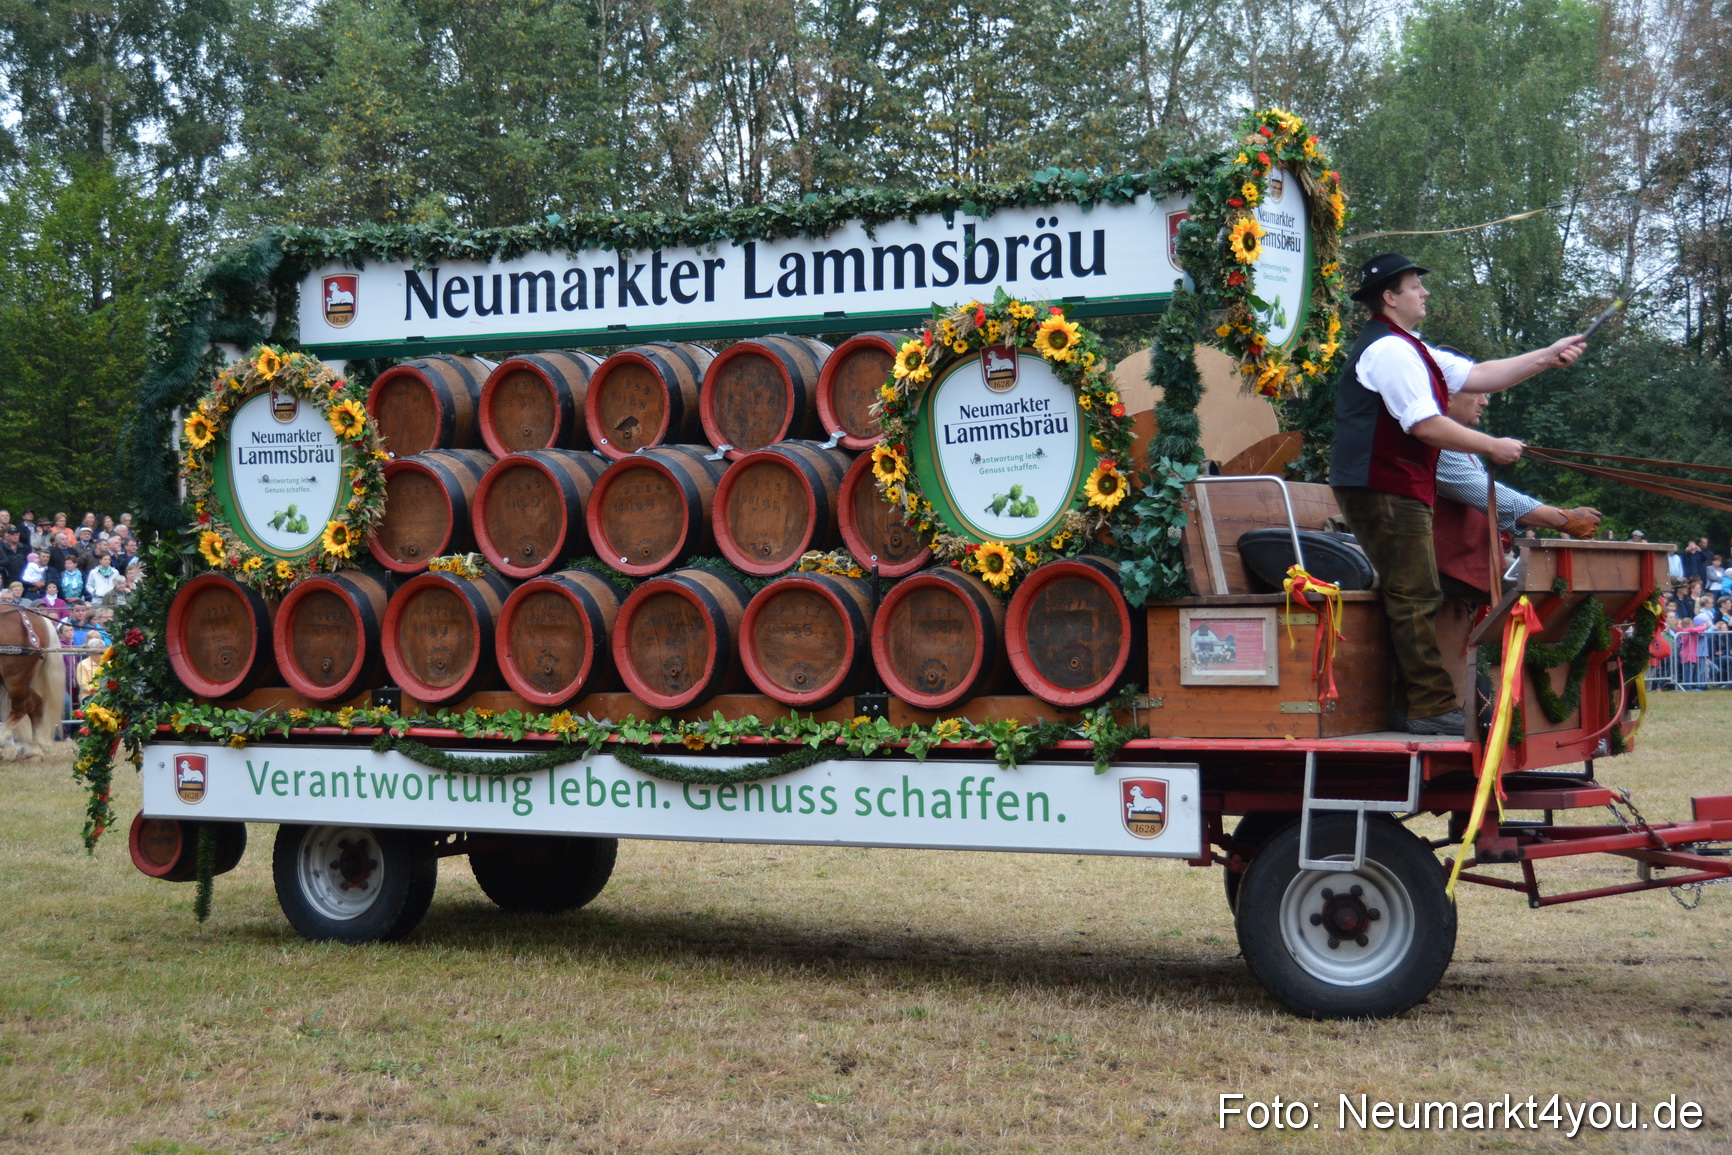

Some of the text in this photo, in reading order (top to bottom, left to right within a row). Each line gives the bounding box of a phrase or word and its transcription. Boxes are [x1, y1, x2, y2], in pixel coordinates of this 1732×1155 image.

[1257, 207, 1295, 228] Neumarkter
[403, 216, 1107, 321] Neumarkter Lammsbräu
[332, 314, 350, 325] 1628
[993, 380, 1010, 389] 1628
[959, 398, 1050, 420] Neumarkter
[251, 429, 322, 444] Neumarkter
[943, 413, 1069, 445] Lammsbräu
[238, 444, 335, 465] Lammsbräu
[979, 463, 1040, 475] Genuss schaffen.
[286, 485, 312, 493] schaffen.
[183, 792, 200, 801] 1628
[245, 760, 1067, 823] Verantwortung leben. Genuss schaffen.
[1135, 823, 1157, 835] 1628
